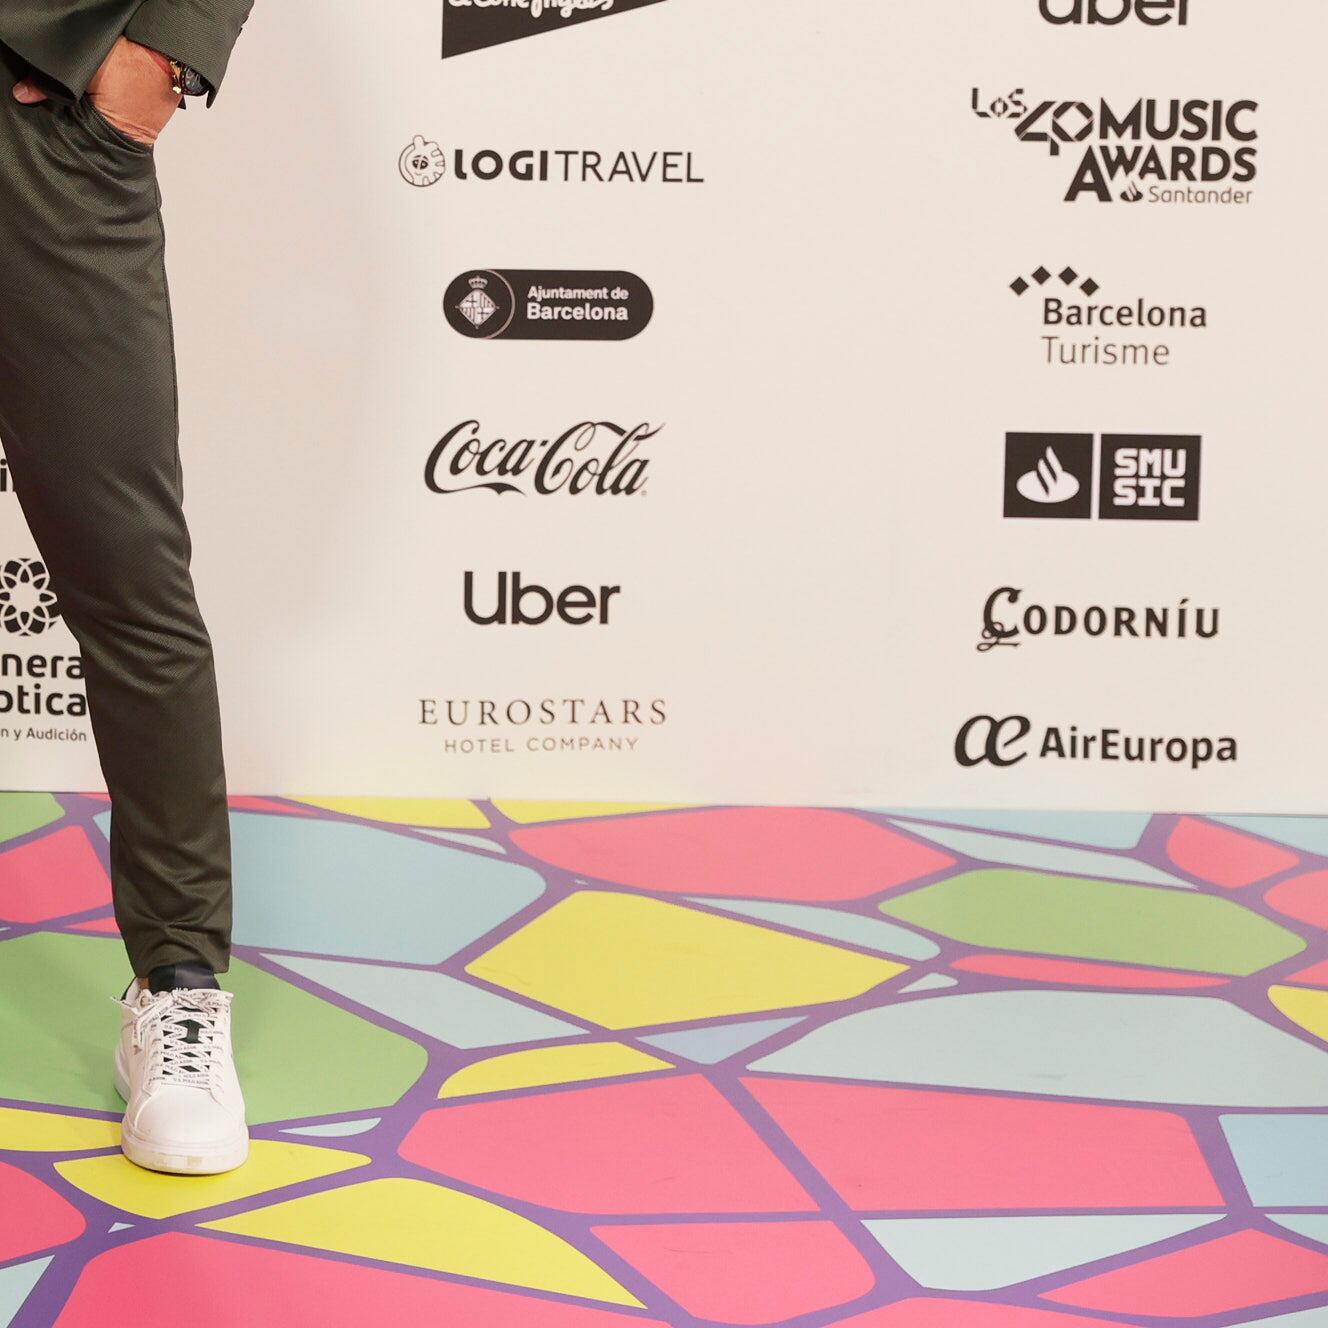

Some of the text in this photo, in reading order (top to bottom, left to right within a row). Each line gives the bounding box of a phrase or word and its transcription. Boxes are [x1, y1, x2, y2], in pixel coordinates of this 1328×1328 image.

[1099, 97, 1259, 142] MUSIC
[454, 148, 704, 183] LOGITRAVEL
[1063, 144, 1257, 202] AWARDS
[1148, 185, 1253, 204] Santander
[527, 285, 629, 302] Ajuntament de
[526, 302, 629, 321] Barcelona
[1042, 297, 1207, 328] Barcelona
[1041, 336, 1170, 365] Turisme
[424, 420, 666, 496] Coca-Cola
[1113, 447, 1187, 478] SMU
[1112, 477, 1186, 507] SIC
[463, 571, 621, 626] Uber
[418, 698, 667, 726] EUROSTARS
[14, 730, 21, 740] y
[26, 728, 87, 741] Audición
[444, 737, 640, 754] HOTEL COMPANY
